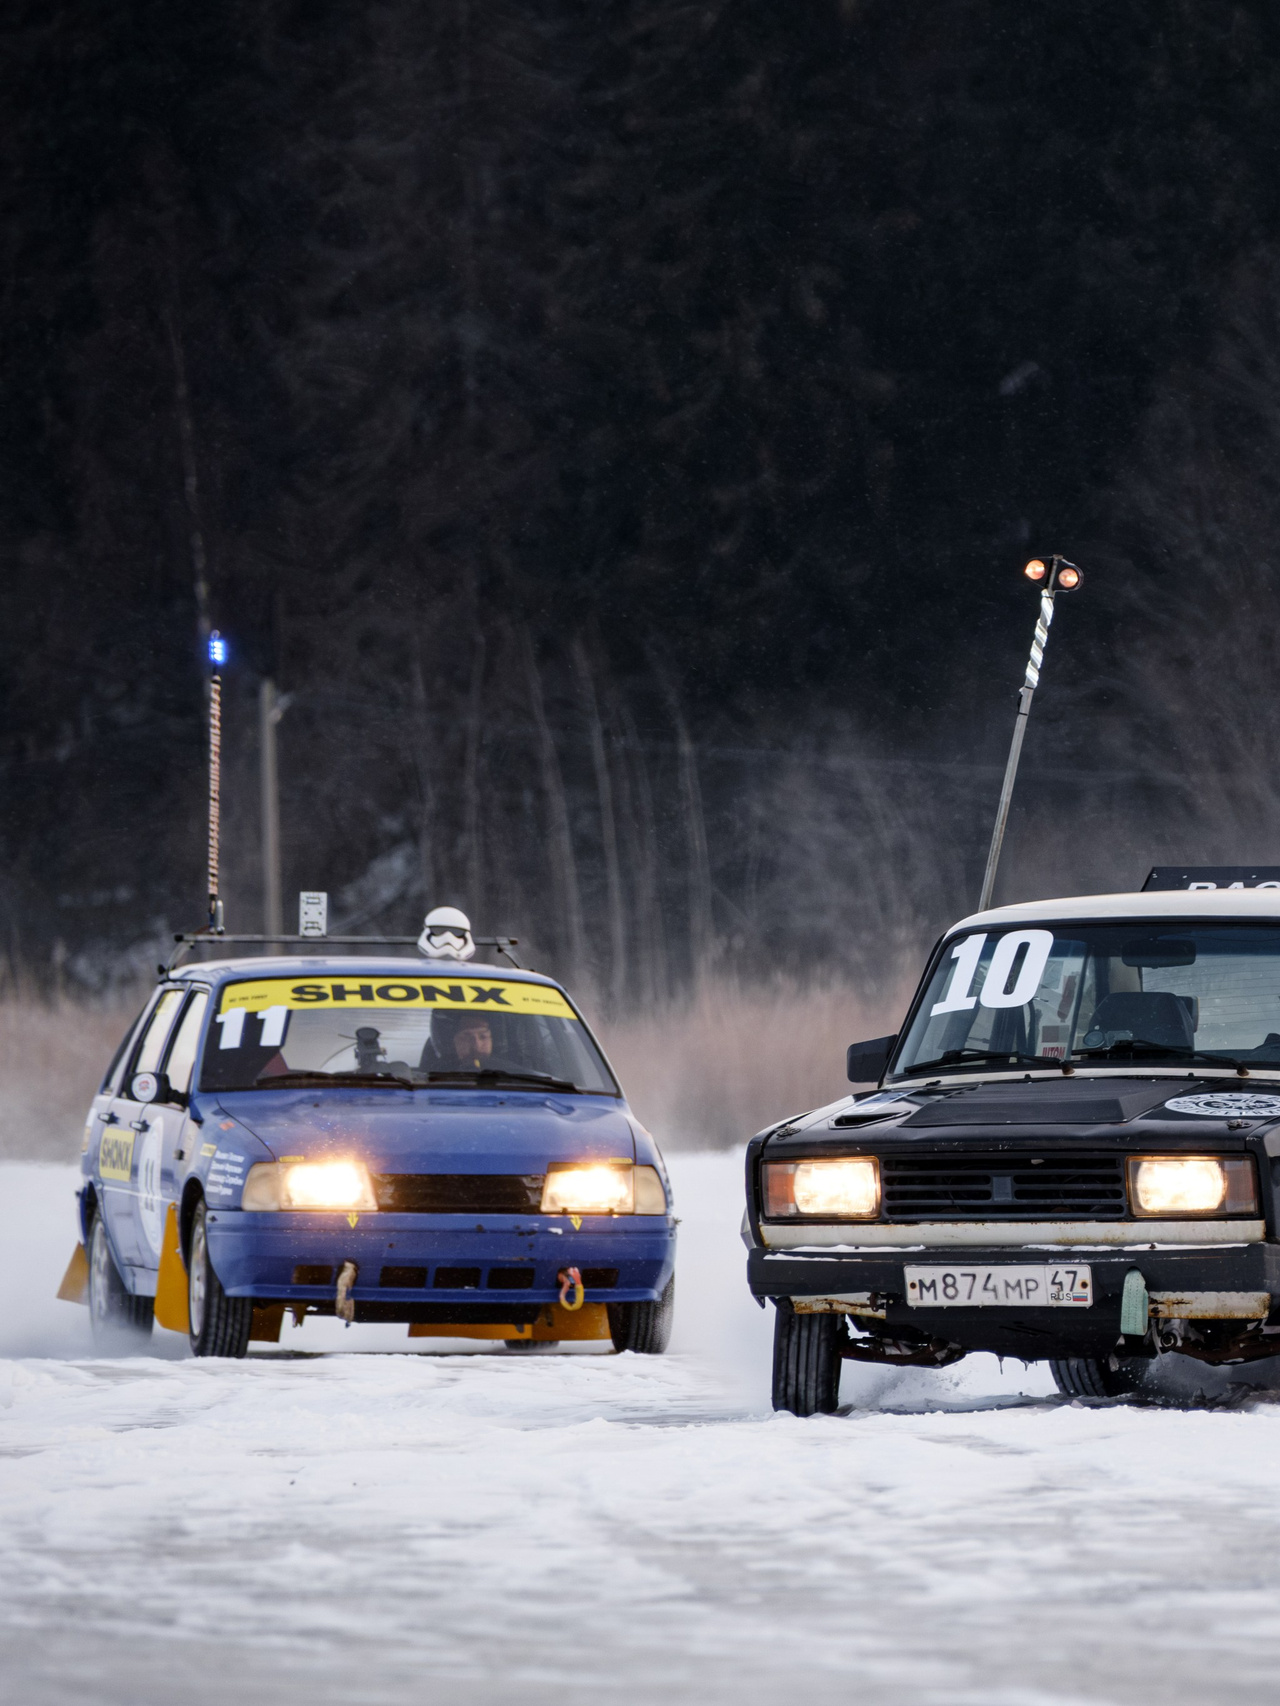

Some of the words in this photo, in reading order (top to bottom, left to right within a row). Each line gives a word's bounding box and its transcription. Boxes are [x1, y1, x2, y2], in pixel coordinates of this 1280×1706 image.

[930, 929, 1054, 1017] 10
[290, 984, 513, 1006] SHONX
[215, 1005, 288, 1050] 11
[1050, 1270, 1078, 1292] 47
[1050, 1293, 1072, 1301] RUS
